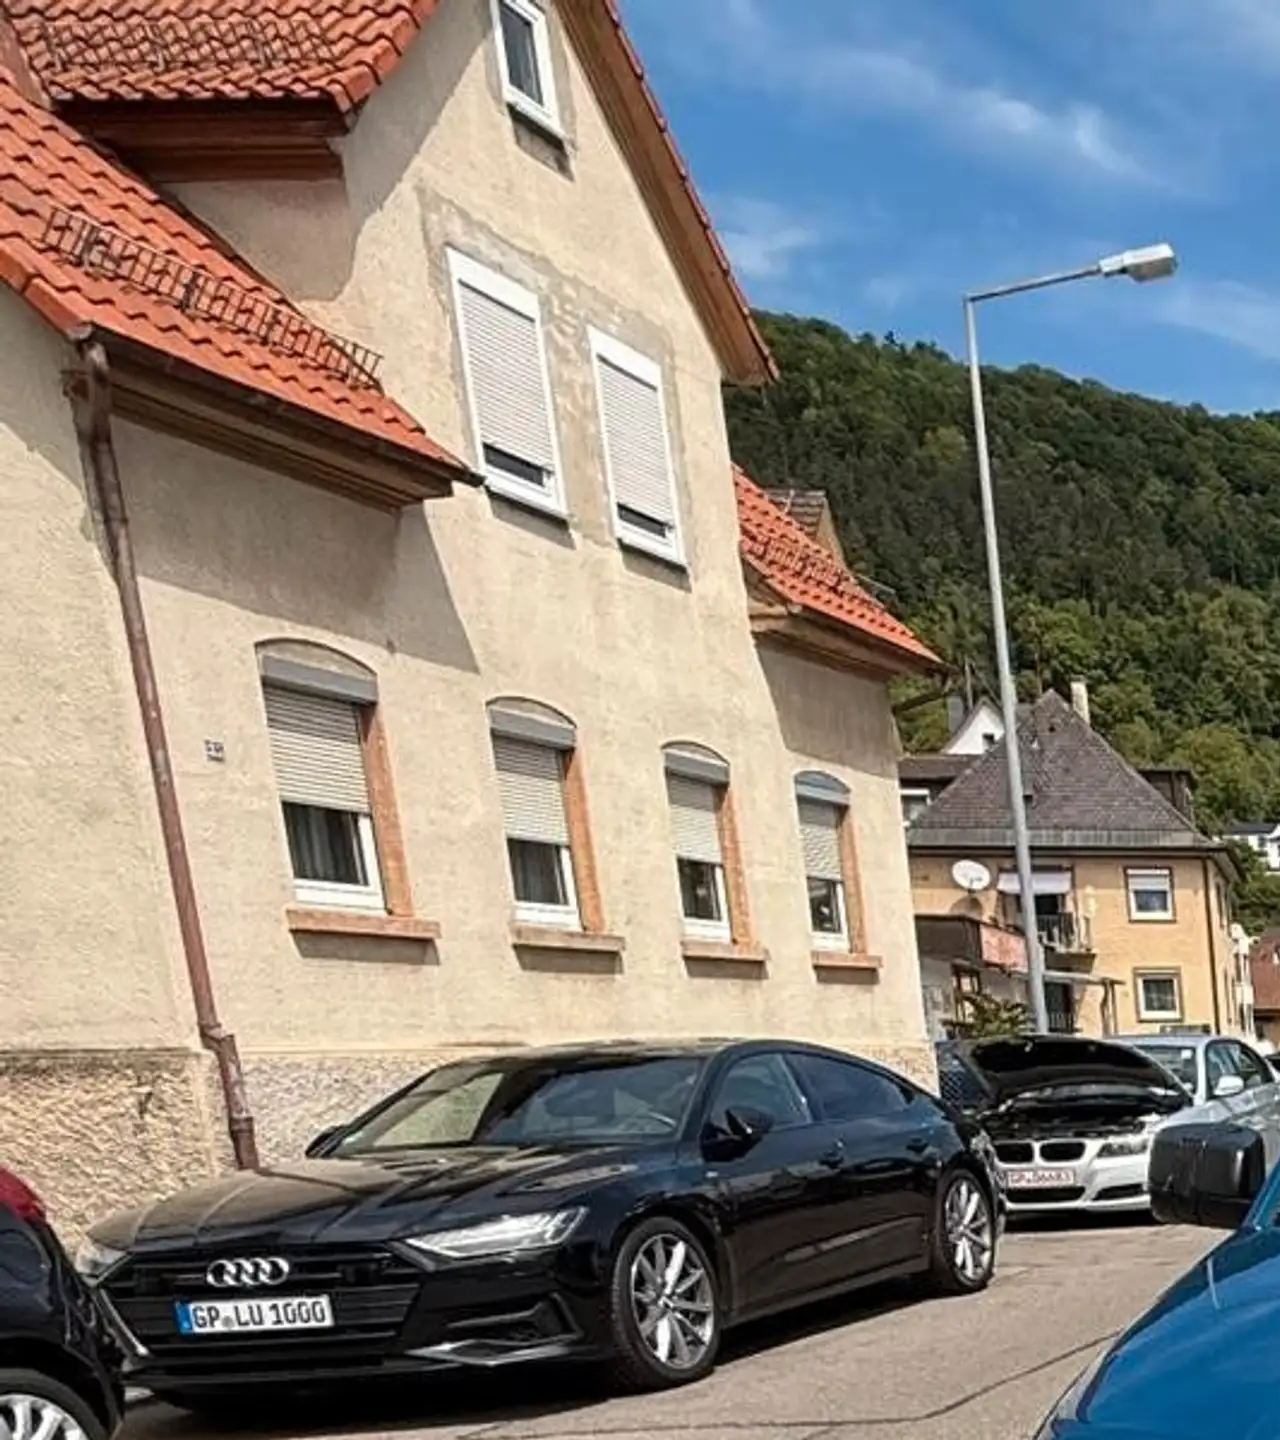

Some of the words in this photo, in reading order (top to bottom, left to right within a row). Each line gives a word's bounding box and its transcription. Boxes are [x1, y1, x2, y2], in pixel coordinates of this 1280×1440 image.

[192, 1306, 220, 1328] GP
[234, 1304, 264, 1326] LU
[268, 1301, 326, 1325] 1000
